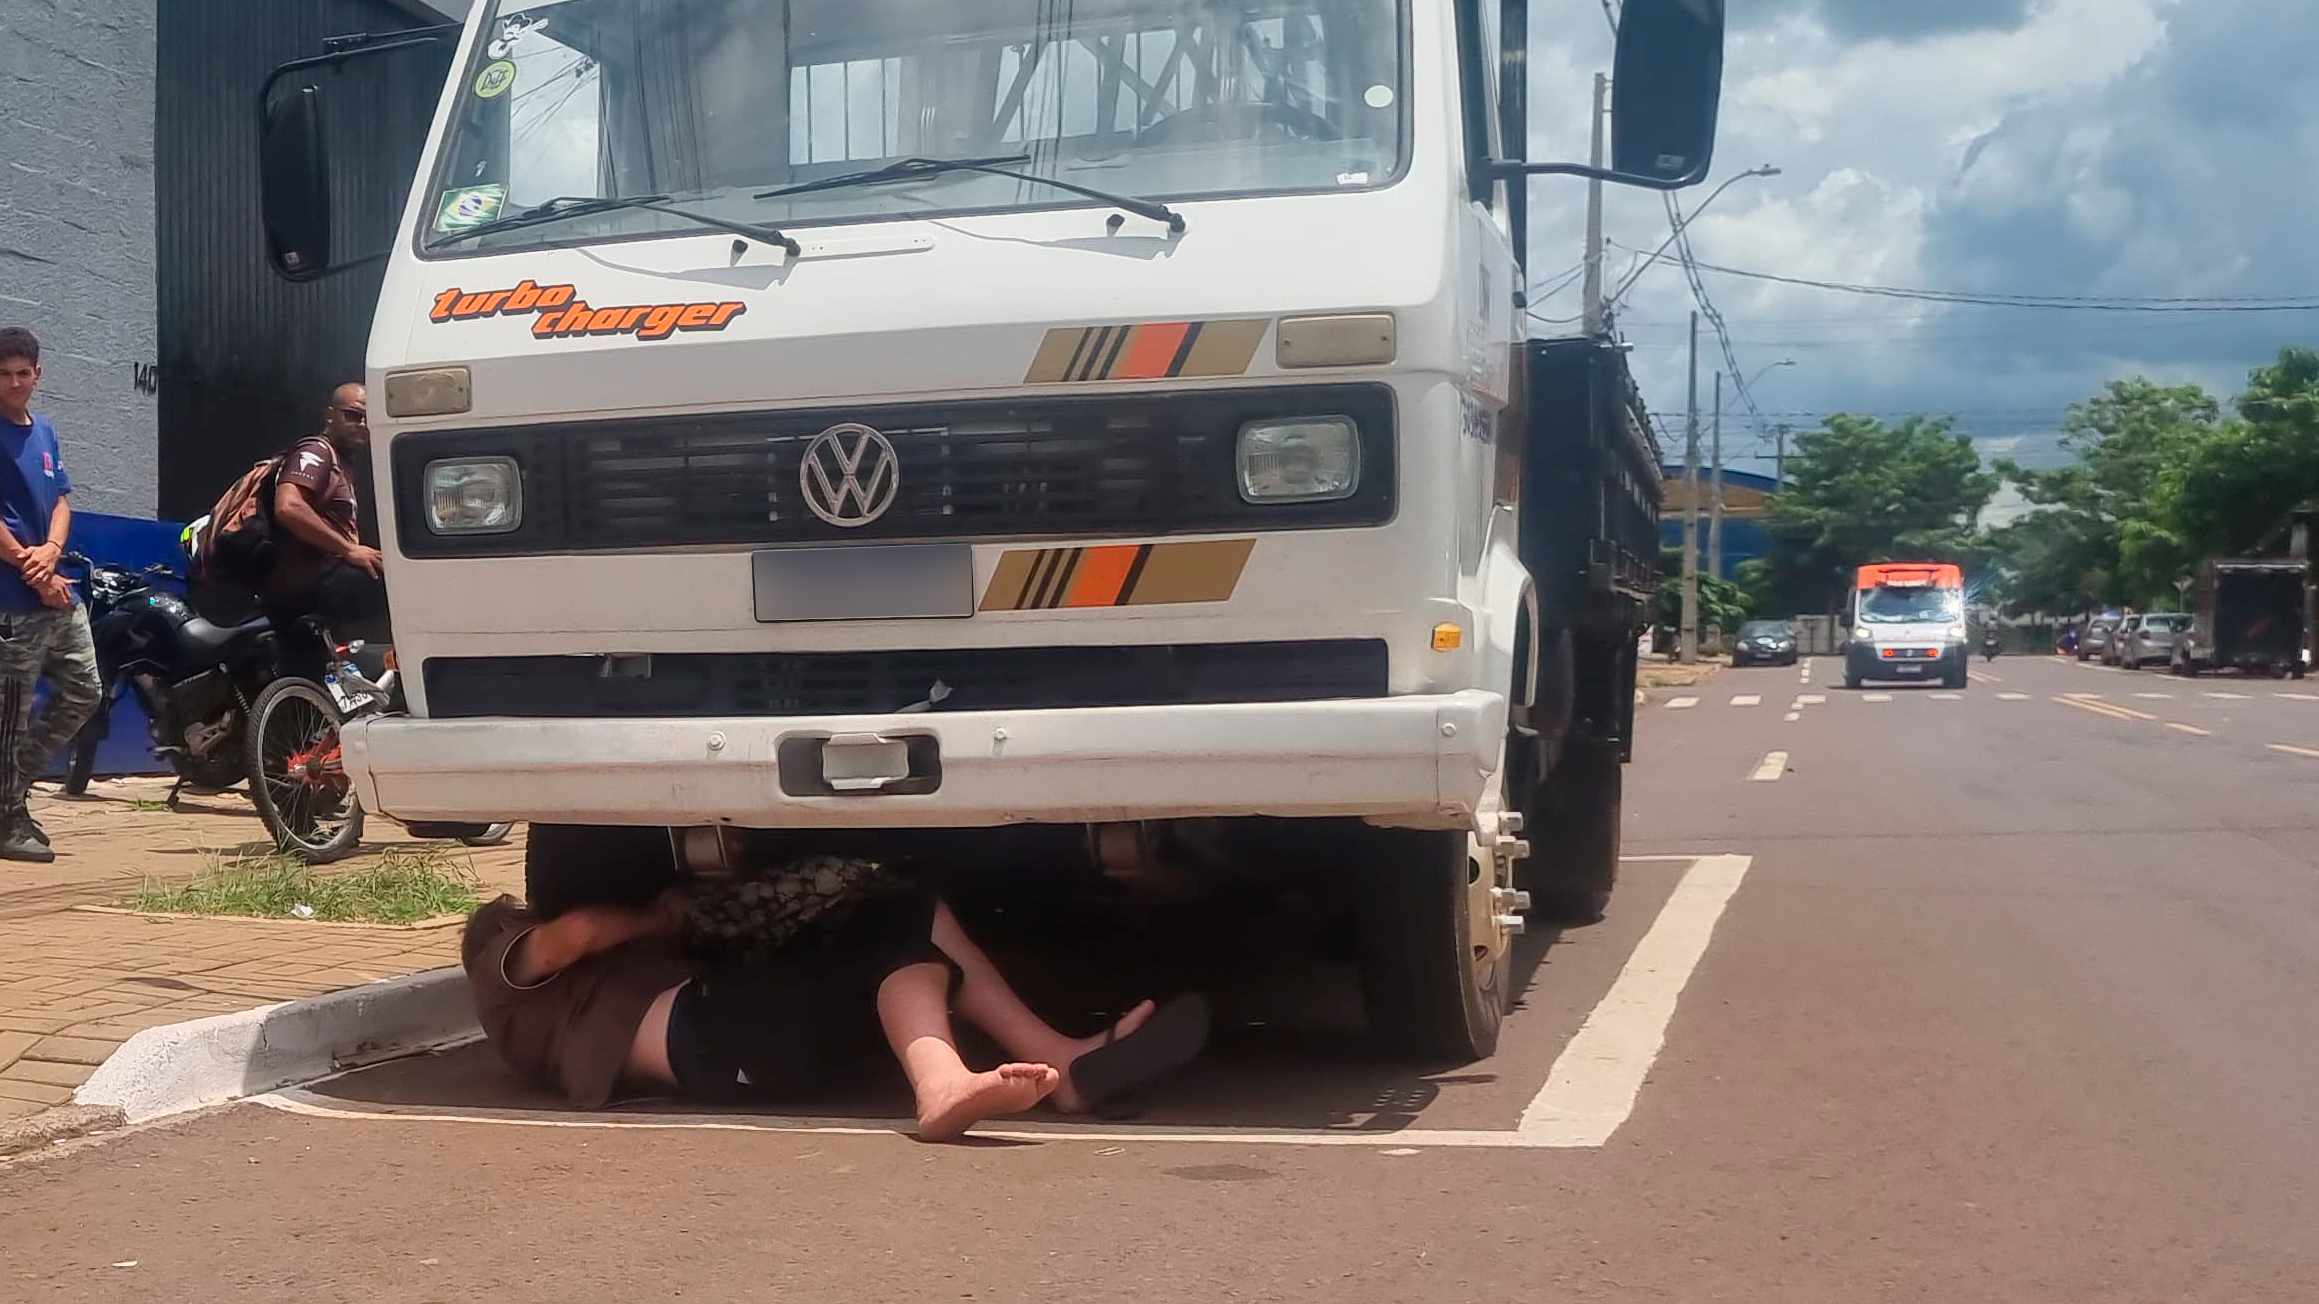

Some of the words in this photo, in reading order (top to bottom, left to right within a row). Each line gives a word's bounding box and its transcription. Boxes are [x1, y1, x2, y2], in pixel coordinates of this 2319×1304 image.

[429, 279, 577, 324] turbo
[531, 300, 747, 341] charger
[134, 361, 157, 396] 140
[800, 423, 899, 528] VW
